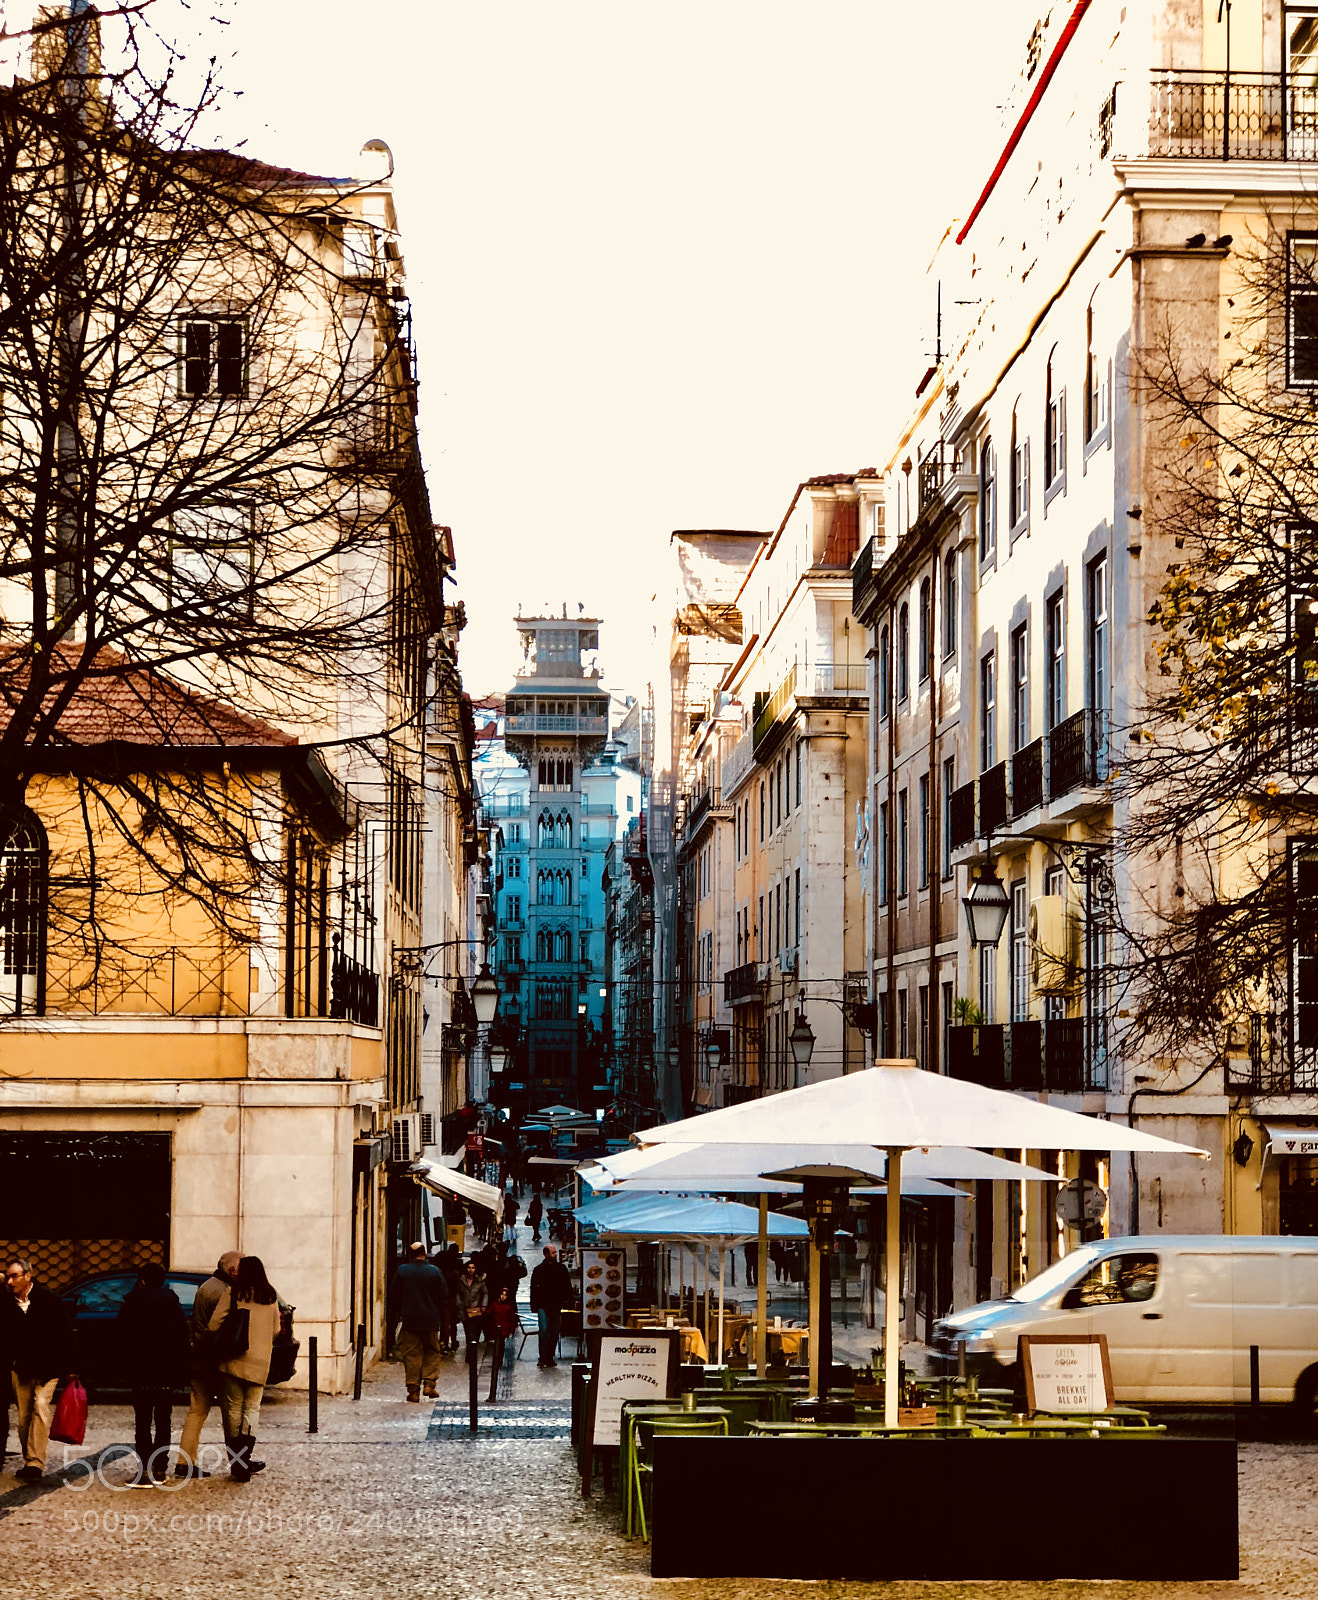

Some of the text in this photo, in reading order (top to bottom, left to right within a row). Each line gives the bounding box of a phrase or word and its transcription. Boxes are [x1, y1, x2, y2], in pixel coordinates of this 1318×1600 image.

[605, 1373, 636, 1388] HEALTHY
[1056, 1385, 1087, 1395] BREKKIE
[1058, 1395, 1088, 1405] ALL DAY
